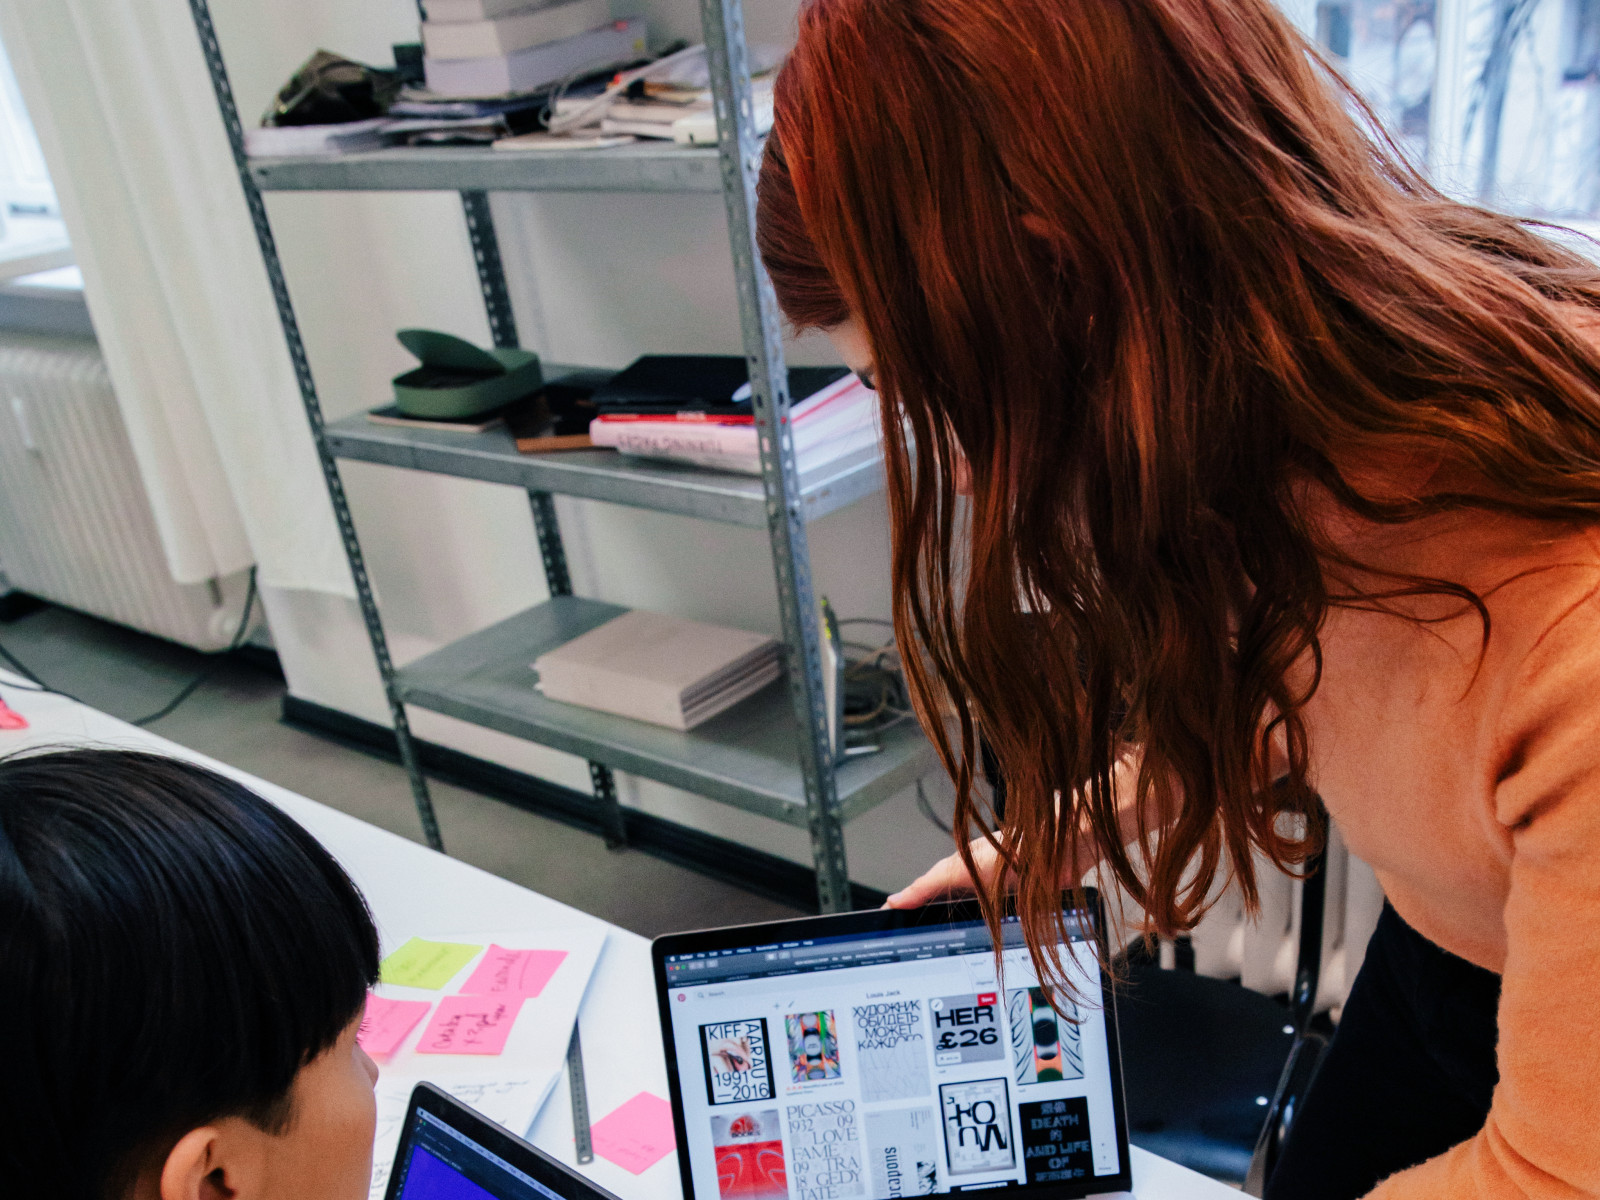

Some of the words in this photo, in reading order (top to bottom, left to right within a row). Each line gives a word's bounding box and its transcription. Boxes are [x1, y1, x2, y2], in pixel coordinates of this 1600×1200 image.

[936, 1005, 994, 1028] HER
[708, 1023, 742, 1040] KIFF
[936, 1028, 998, 1050] £26
[745, 1023, 767, 1079] AARAU
[714, 1071, 749, 1087] 1991
[786, 1099, 856, 1120] PICASSO
[788, 1118, 814, 1134] 1932
[837, 1114, 854, 1128] 09
[812, 1128, 858, 1145] LOVE
[792, 1144, 840, 1161] FAME
[1060, 1140, 1090, 1154] LIFE
[794, 1161, 810, 1175] 09
[824, 1156, 860, 1172] TRA
[816, 1168, 862, 1186] GEDY
